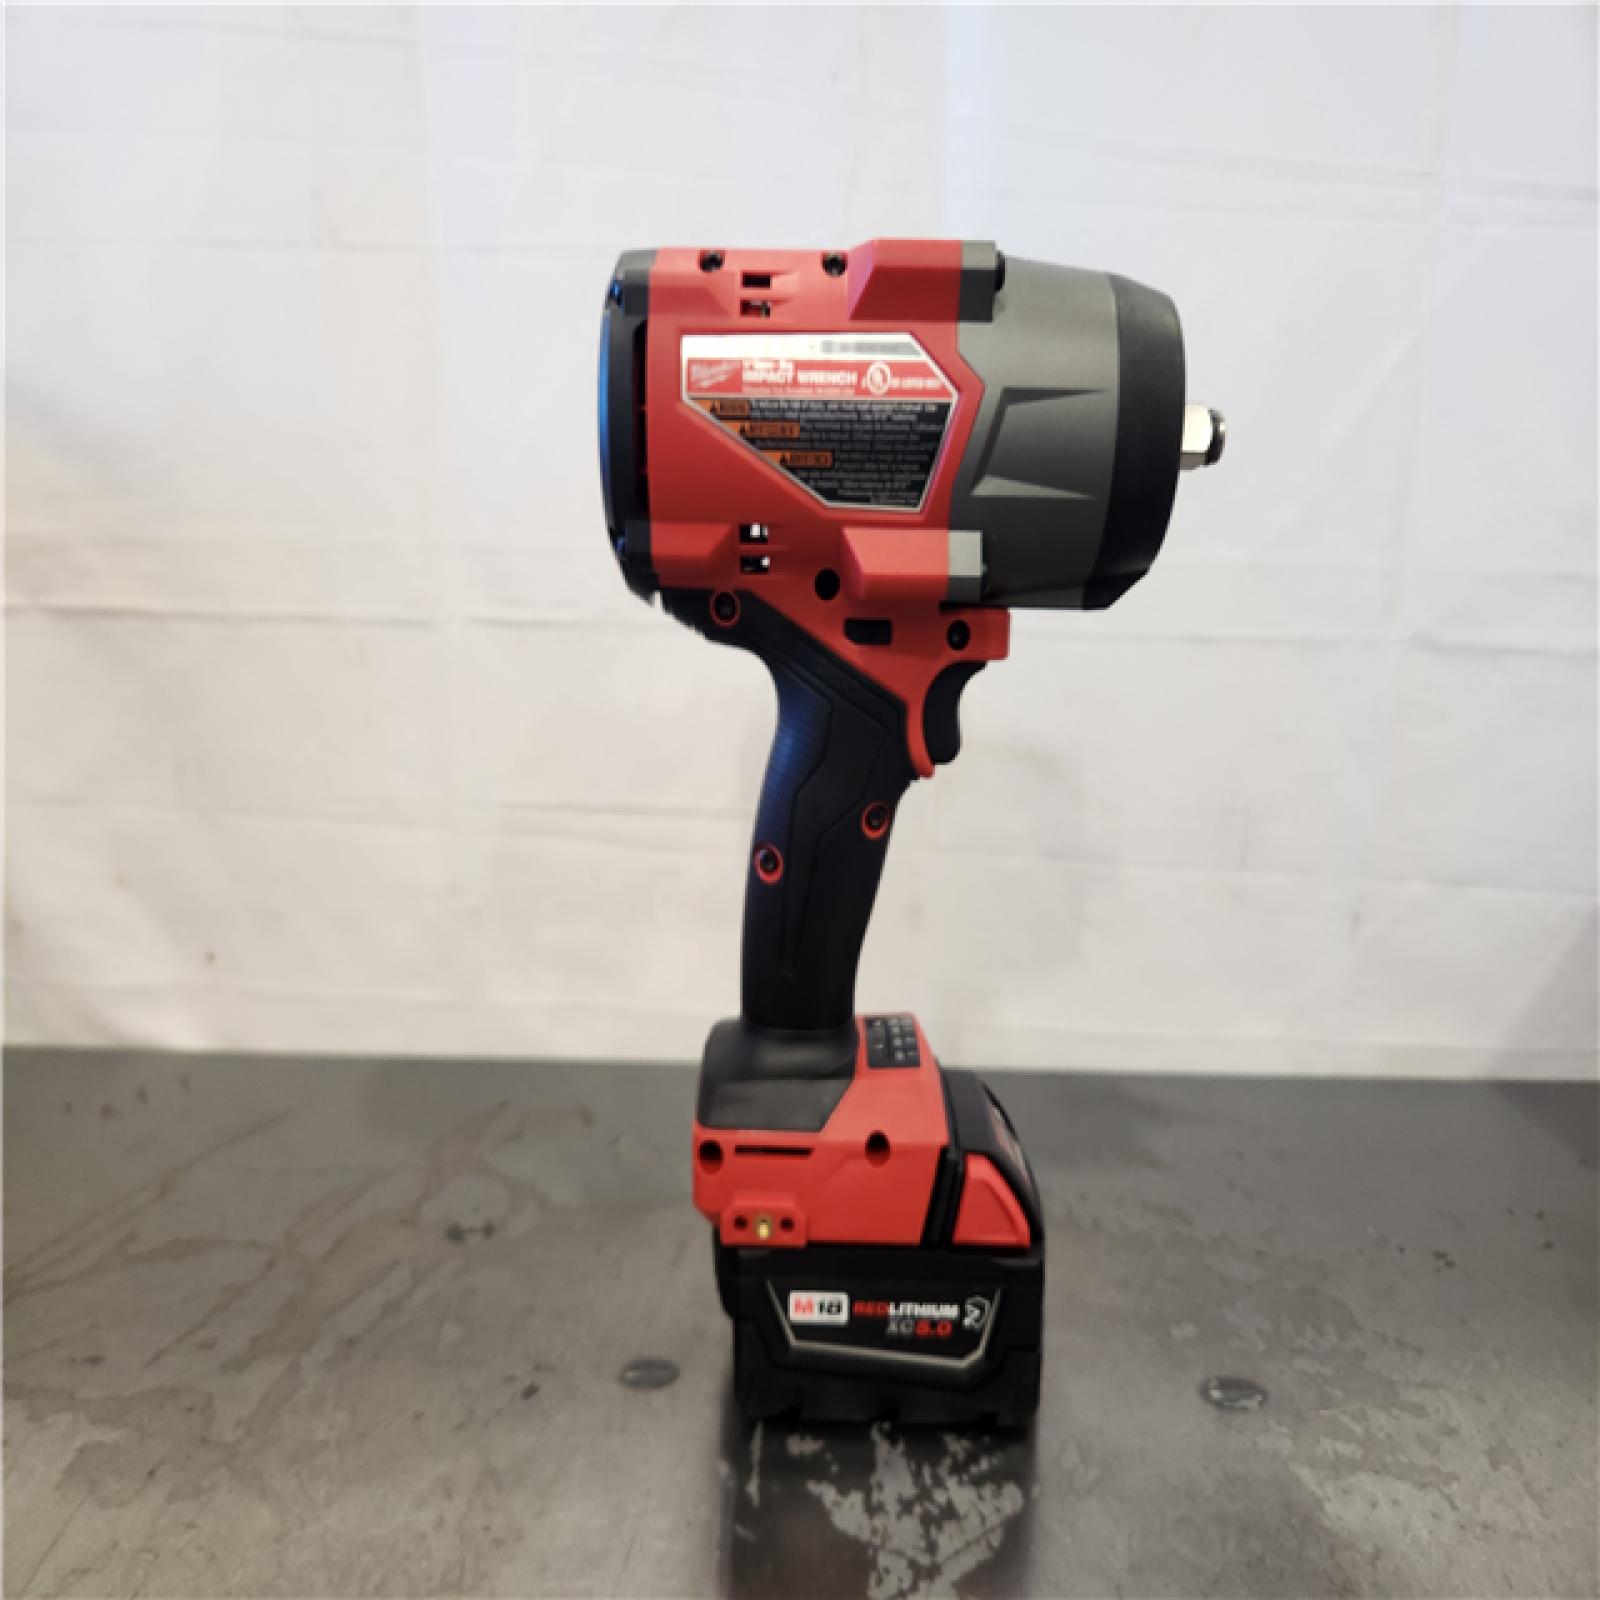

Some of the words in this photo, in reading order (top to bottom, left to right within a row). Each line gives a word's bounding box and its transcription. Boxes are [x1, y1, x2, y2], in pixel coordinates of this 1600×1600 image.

[743, 369, 793, 383] IMPACT
[798, 371, 857, 385] WRENCH
[793, 1296, 842, 1315] M18
